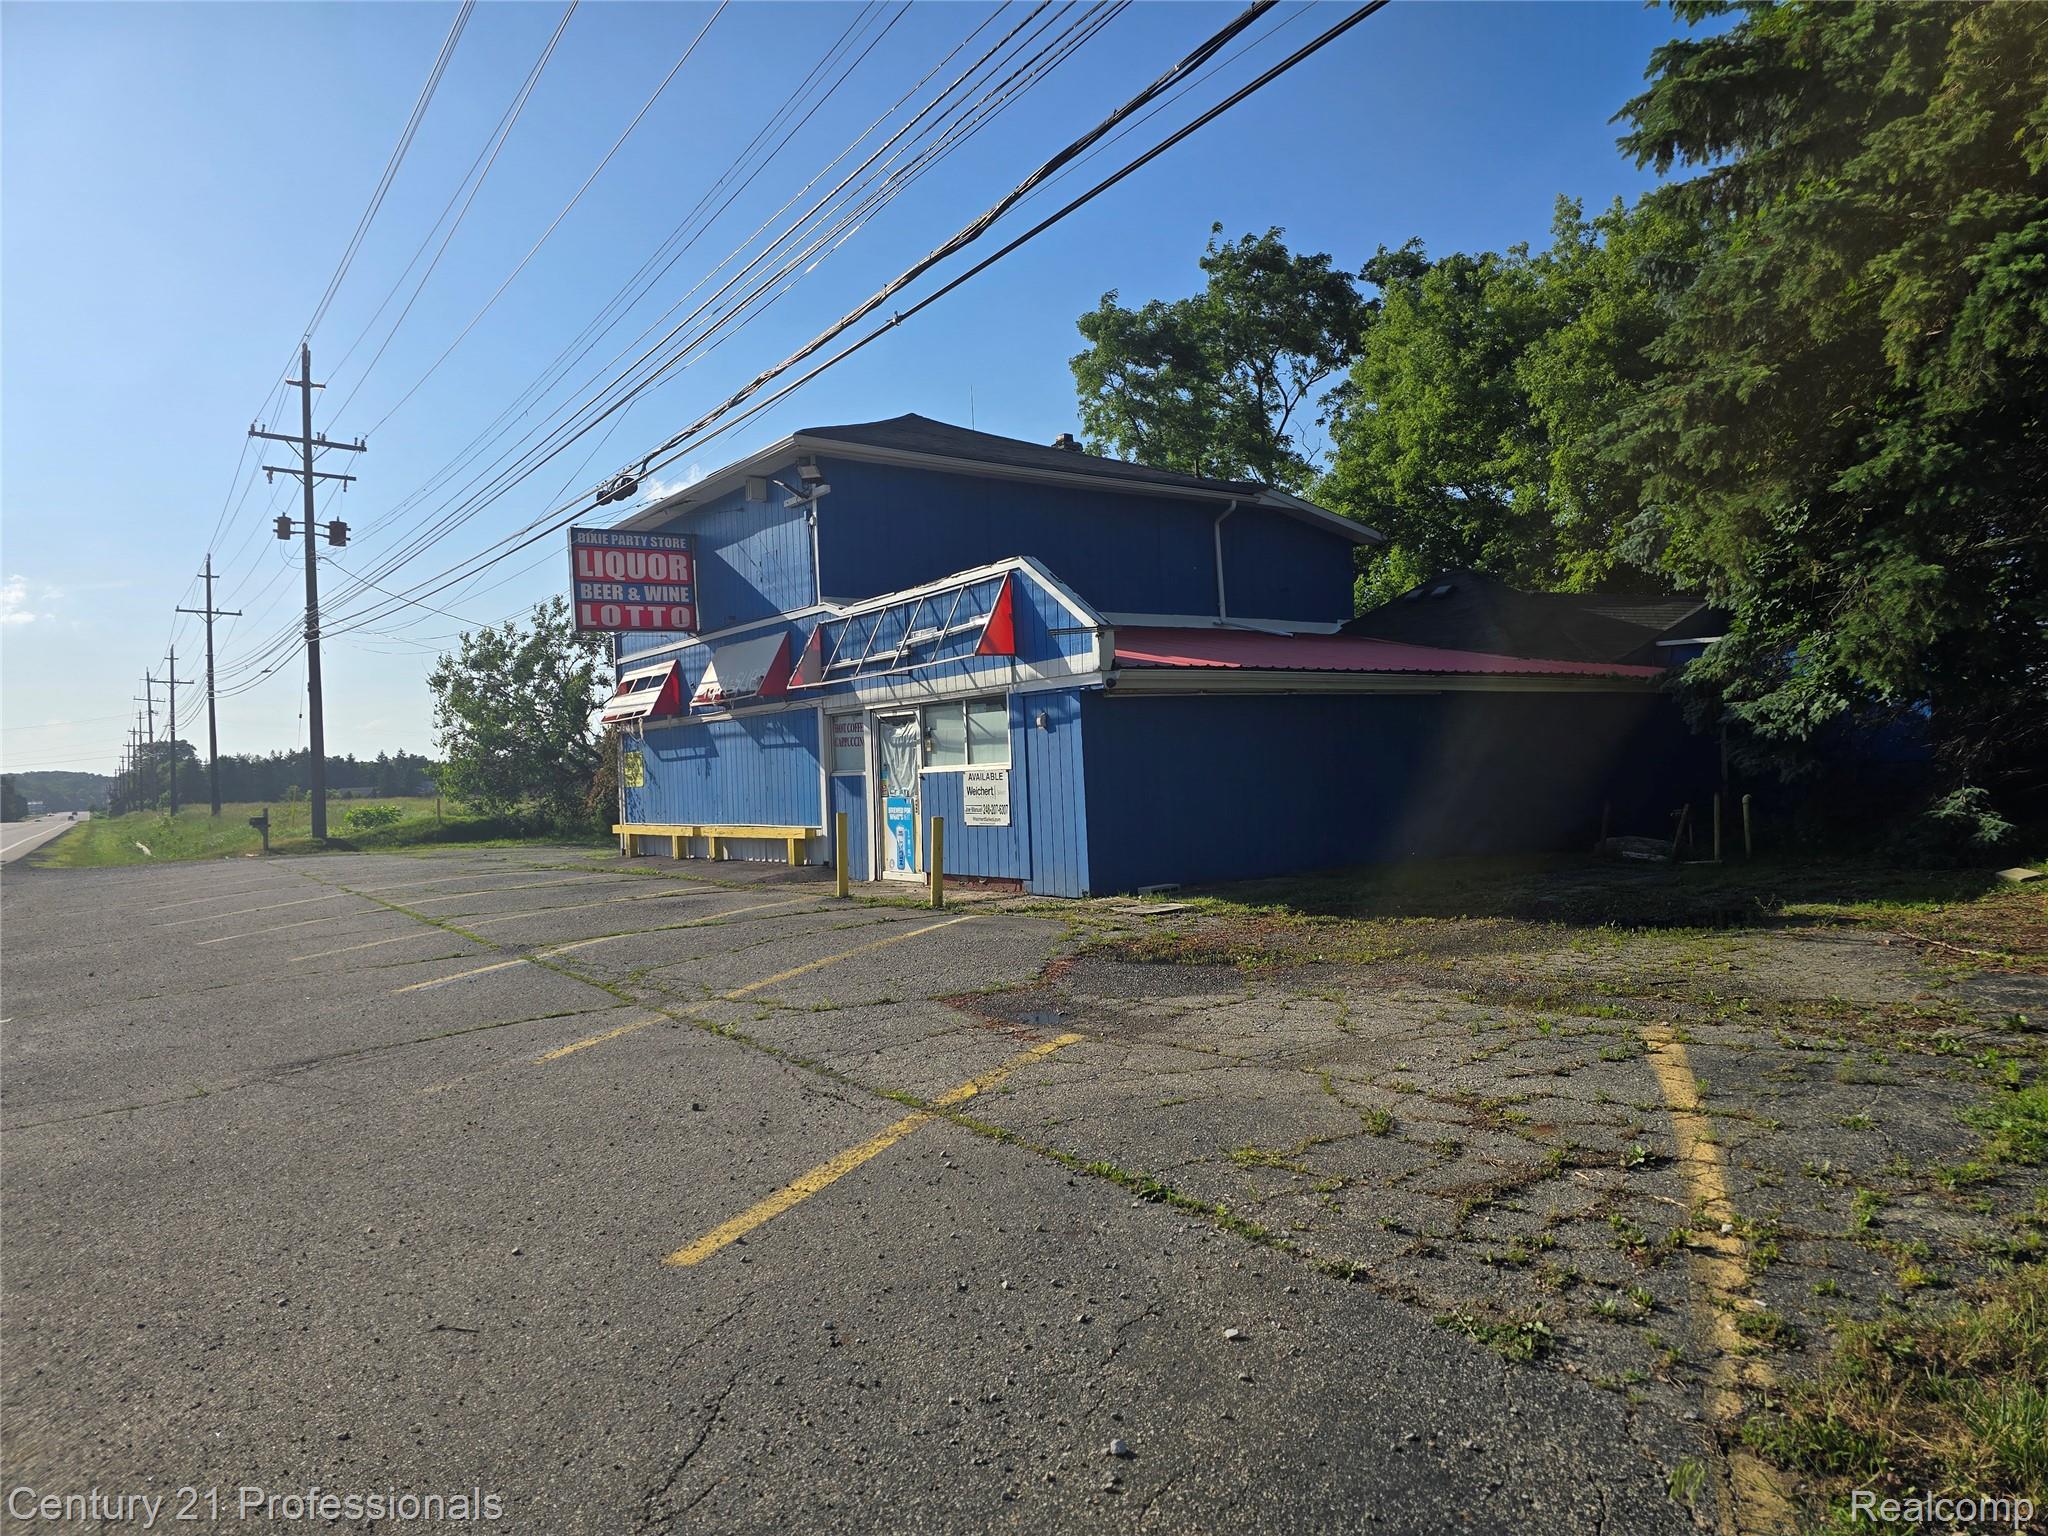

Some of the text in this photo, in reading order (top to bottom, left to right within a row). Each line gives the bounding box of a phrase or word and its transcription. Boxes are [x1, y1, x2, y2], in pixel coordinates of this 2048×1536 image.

[611, 534, 648, 547] PARTY
[650, 536, 687, 549] STORE
[578, 549, 688, 581] LIQUOR
[580, 583, 690, 603] BEER & WINE
[581, 604, 690, 628] LOTTO
[833, 723, 847, 733] HOT
[968, 772, 1004, 781] AVAILABLE
[966, 785, 994, 796] Weichert
